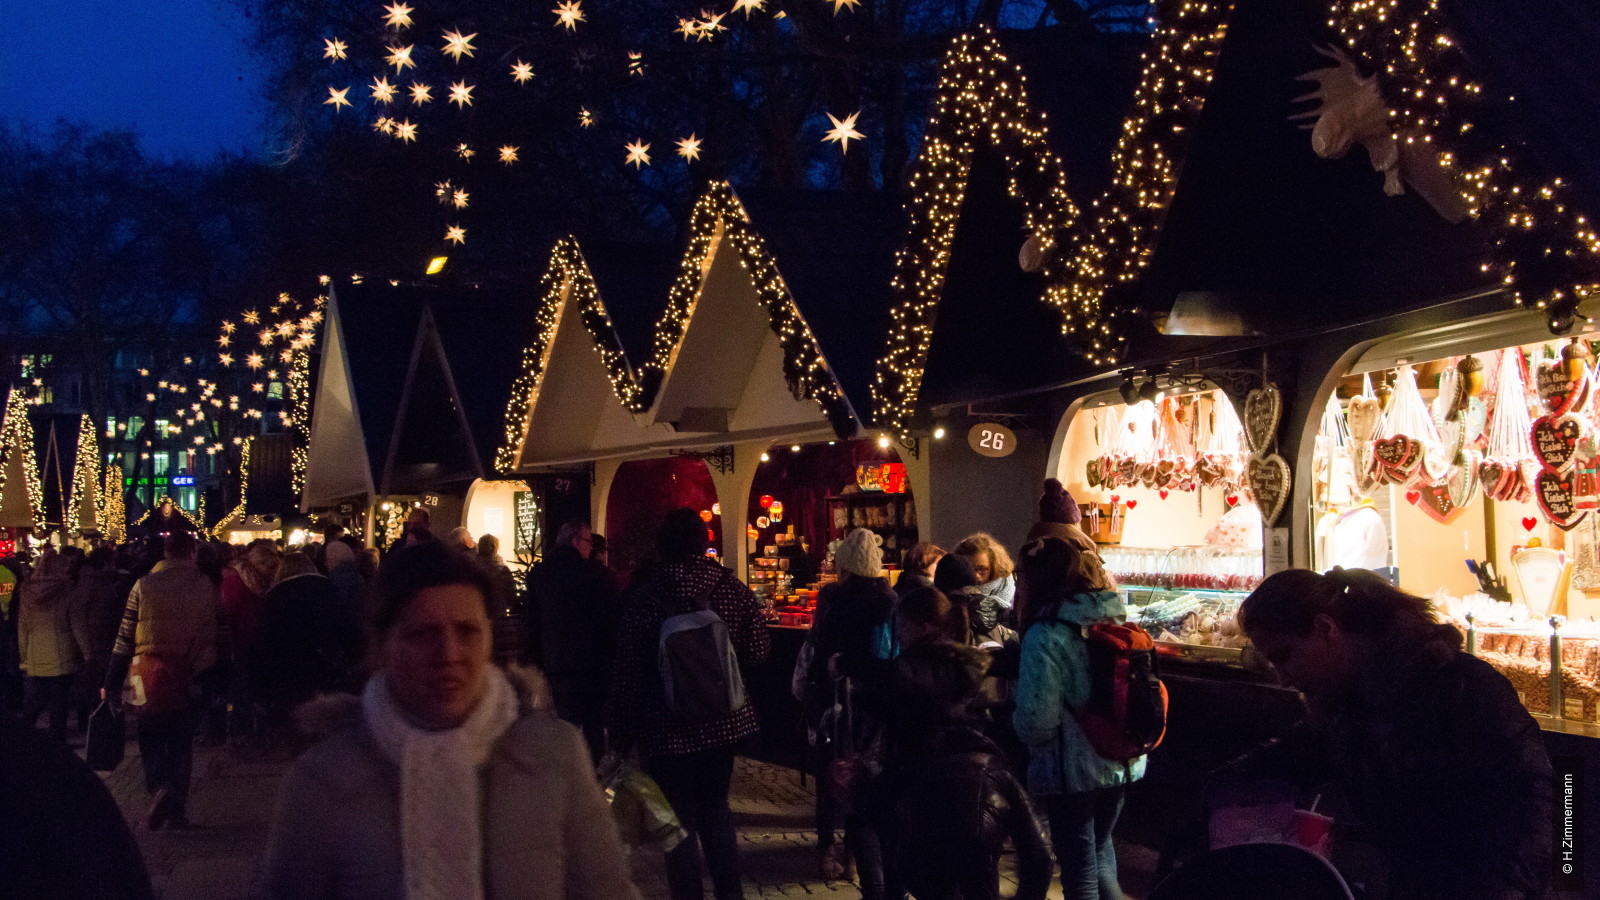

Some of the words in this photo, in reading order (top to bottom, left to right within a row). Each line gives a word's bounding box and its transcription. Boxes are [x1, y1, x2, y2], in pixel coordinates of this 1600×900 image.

[980, 430, 1004, 450] 26
[1537, 431, 1555, 442] Ich
[1539, 442, 1562, 453] liebe
[1545, 452, 1565, 464] Dich
[555, 479, 571, 490] 27
[1541, 481, 1560, 492] Ich
[425, 495, 438, 506] 28
[1544, 491, 1565, 503] liebe
[1550, 503, 1569, 514] Dich
